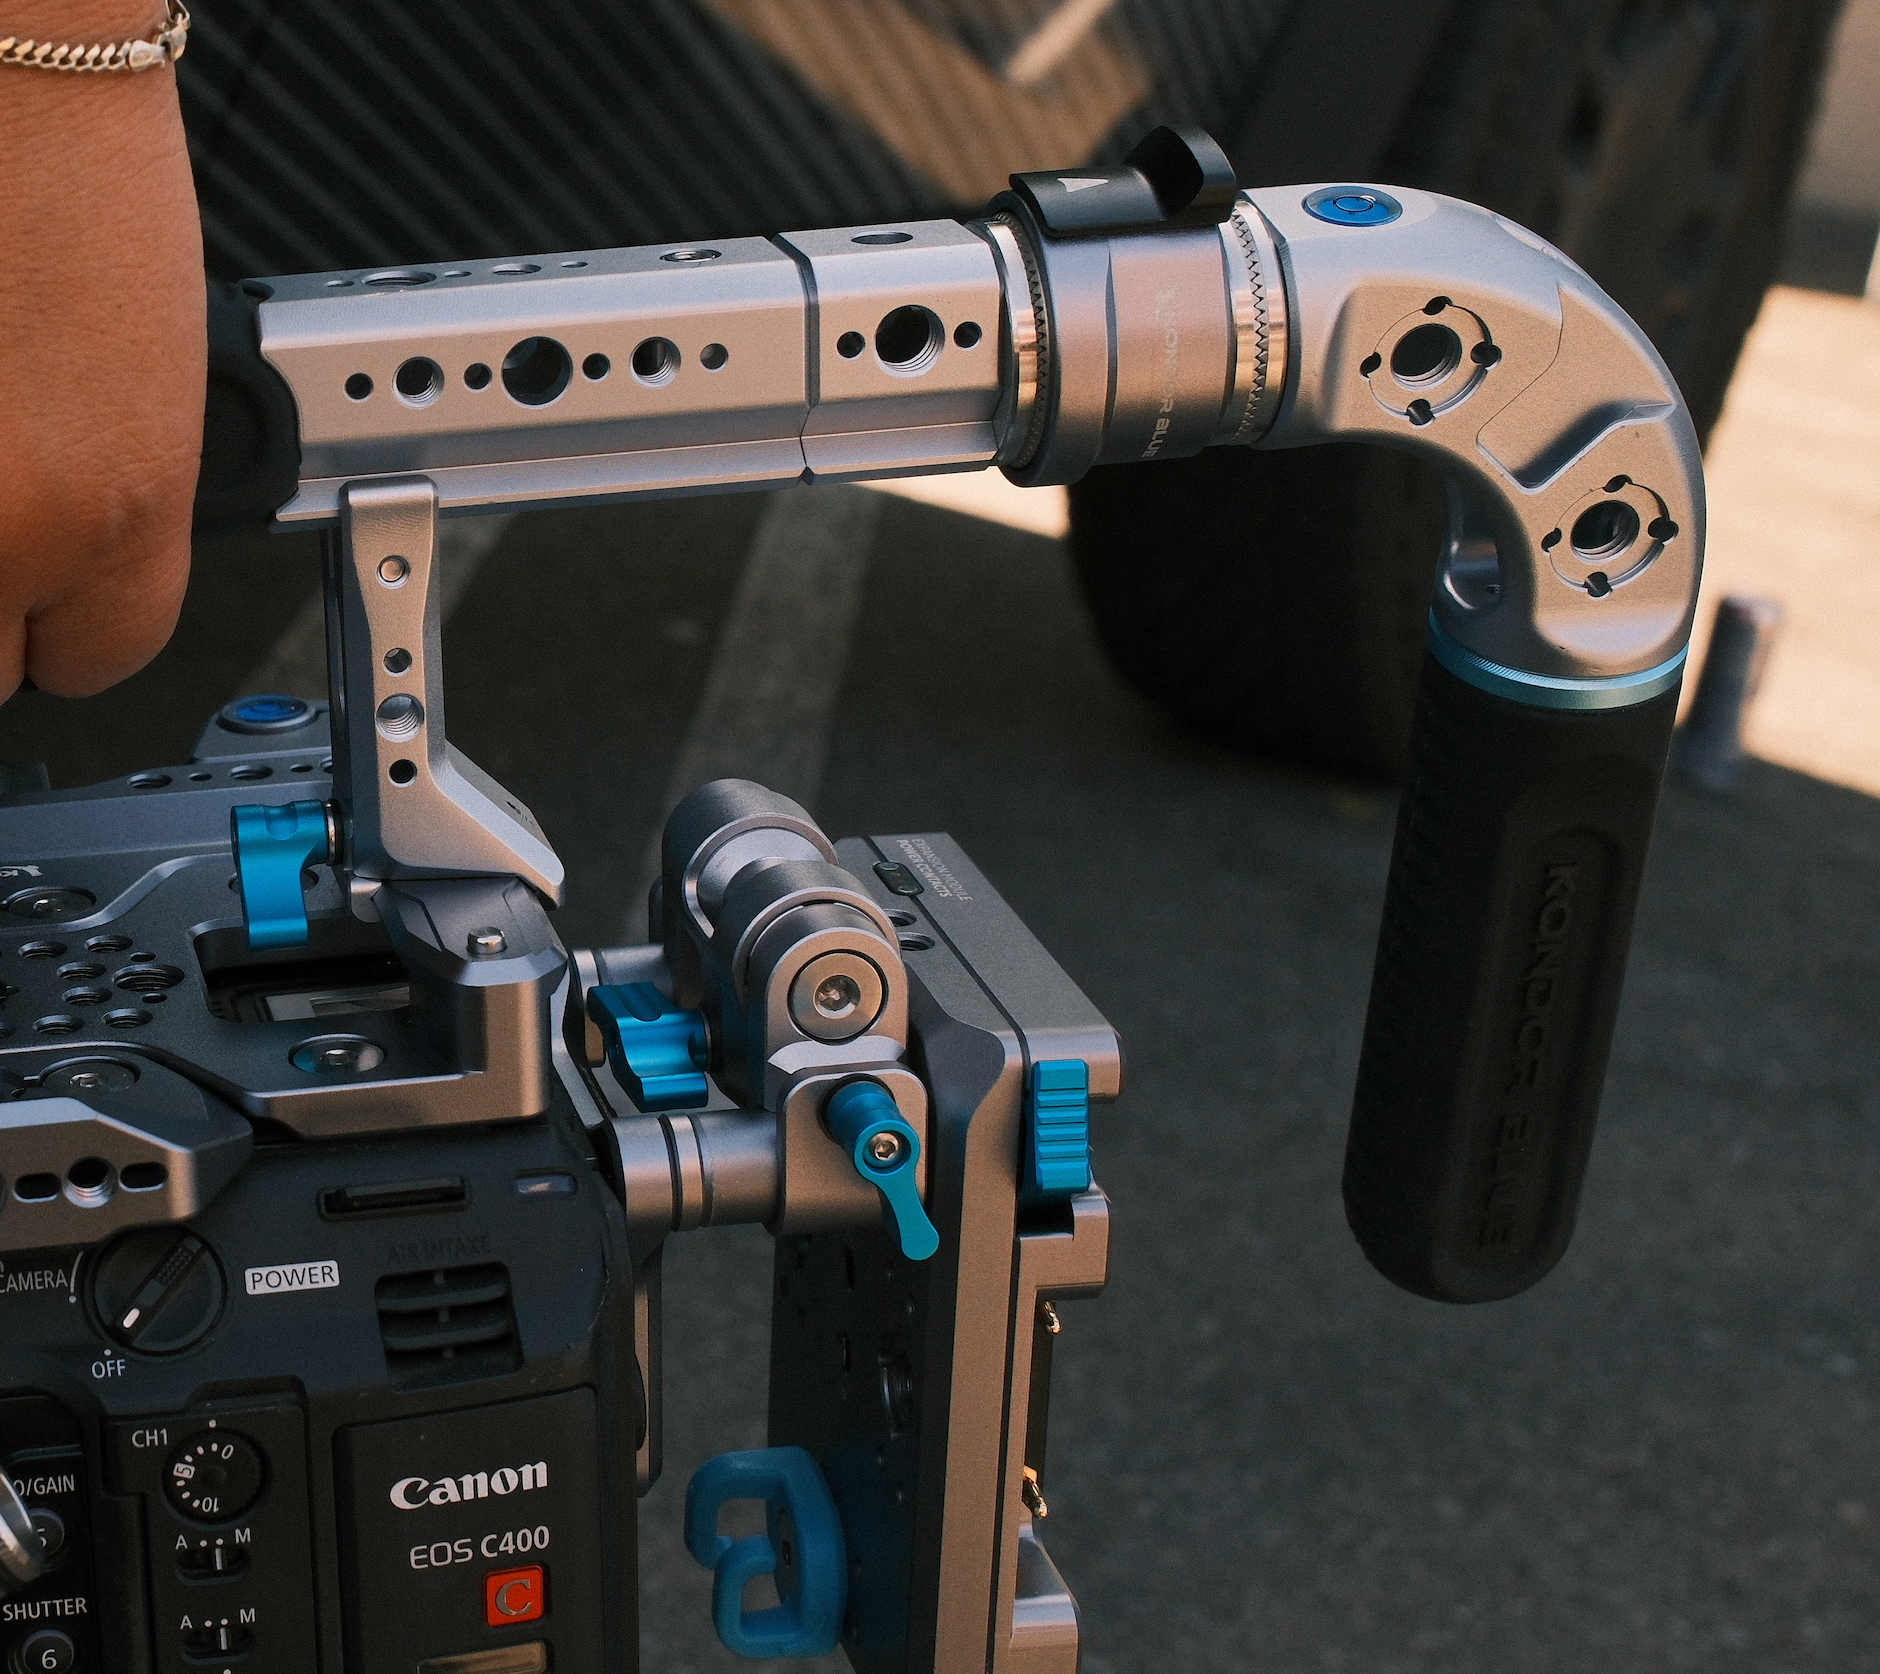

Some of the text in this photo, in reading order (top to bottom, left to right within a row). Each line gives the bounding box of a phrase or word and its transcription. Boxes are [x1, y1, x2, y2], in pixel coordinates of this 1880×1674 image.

[1141, 418, 1170, 458] BLUE
[896, 839, 953, 898] POWER CONTACTS
[1507, 863, 1583, 1096] KONDOR
[251, 1264, 335, 1290] POWER
[91, 1359, 126, 1379] OFF
[131, 1428, 168, 1448] CH1
[221, 1444, 234, 1460] 0
[13, 1475, 75, 1497] O/GAIN
[389, 1461, 548, 1510] Canon
[202, 1496, 220, 1513] 10
[176, 1527, 252, 1550] A M
[410, 1525, 550, 1570] EOS C400
[495, 1578, 532, 1616] C
[2, 1597, 88, 1621] SHUTTER
[180, 1608, 256, 1630] A M
[41, 1649, 57, 1670] 6
